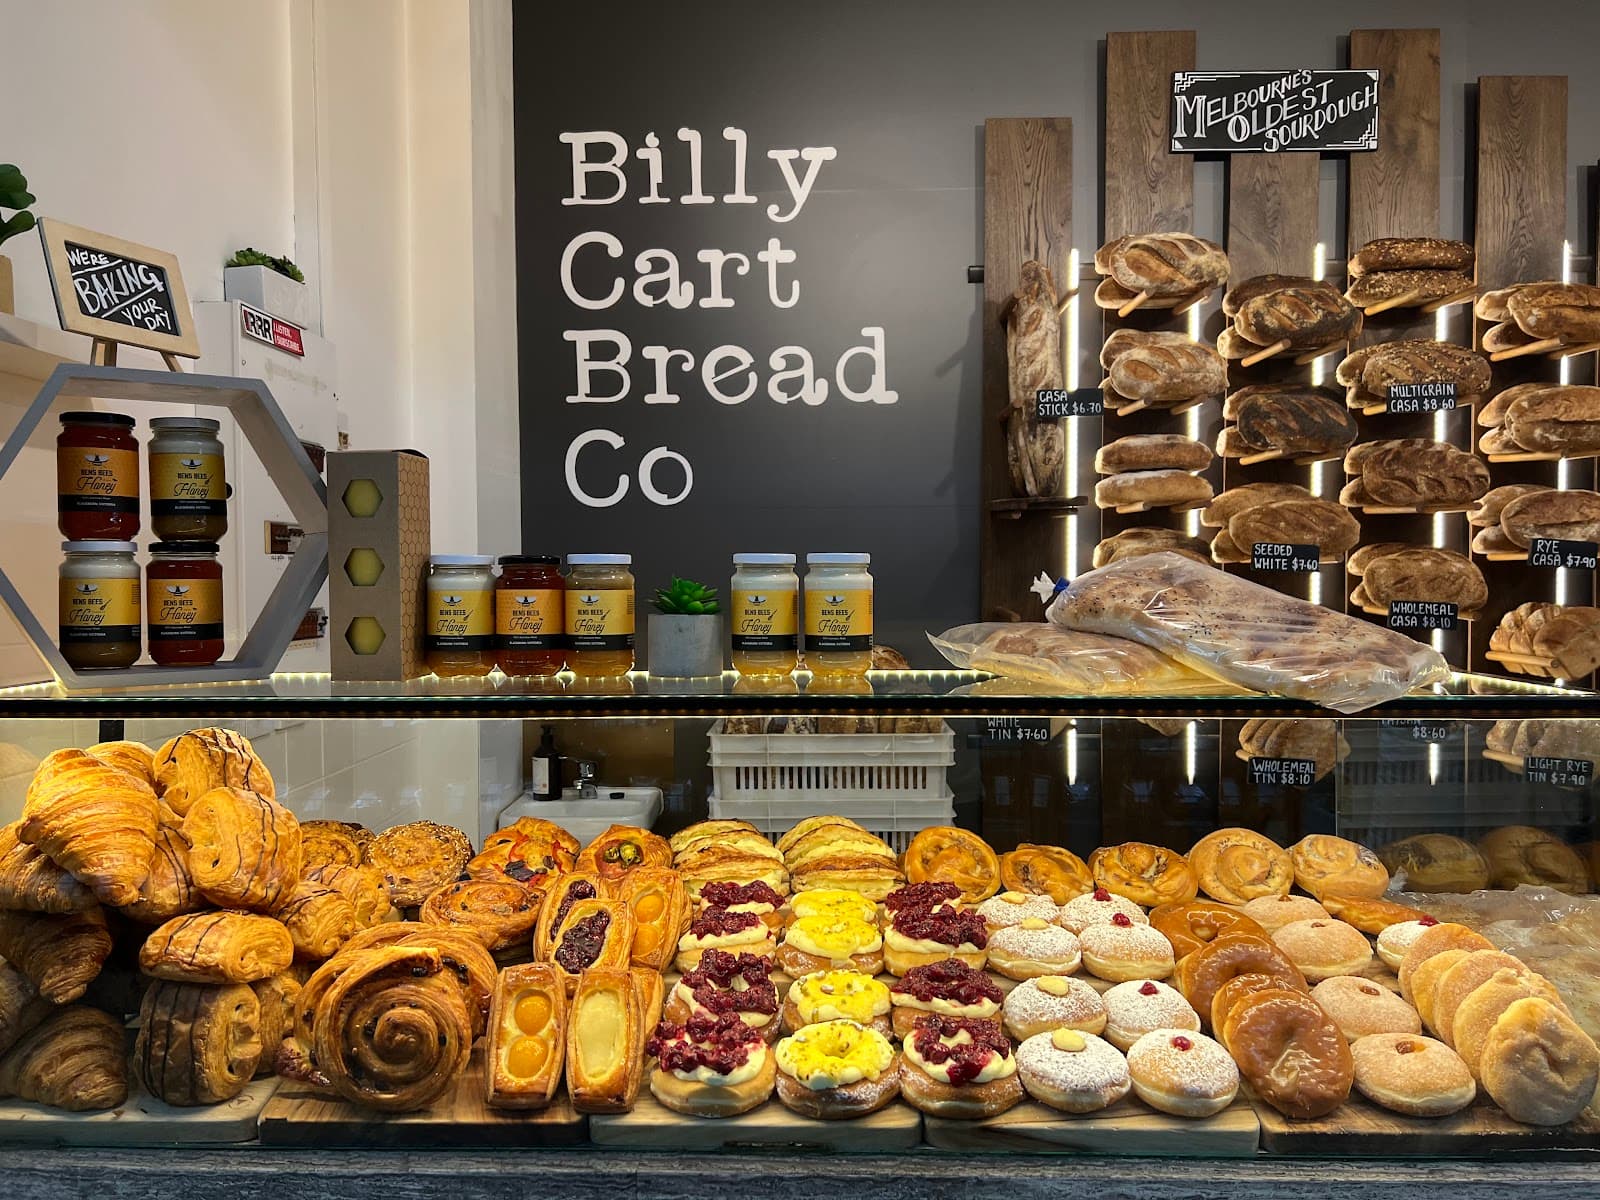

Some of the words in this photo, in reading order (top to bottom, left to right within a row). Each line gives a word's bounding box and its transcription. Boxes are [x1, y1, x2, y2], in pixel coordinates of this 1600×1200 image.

[1227, 79, 1334, 142] OLDEST
[1264, 82, 1378, 152] SOURDOUGH
[558, 126, 837, 222] Billy
[560, 231, 800, 309] Cart
[74, 262, 164, 314] BAKING
[121, 298, 163, 326] YOUR
[144, 310, 171, 330] DAY
[562, 327, 899, 405] Bread
[1039, 390, 1068, 402] CASA
[1390, 383, 1454, 398] MULTIGRAIN
[1038, 403, 1069, 416] STICK
[1072, 401, 1102, 415] $6.70
[1390, 399, 1419, 413] CASA
[564, 429, 694, 508] Co
[76, 476, 117, 494] Honey
[174, 482, 210, 498] Honey
[1254, 543, 1293, 557] SEEDED
[1536, 539, 1560, 554] RYE
[1254, 557, 1288, 571] WHITE
[1291, 556, 1318, 572] $7.60
[1532, 553, 1561, 567] CASA
[1566, 552, 1597, 569] $7.90
[70, 608, 106, 625] Honey
[160, 606, 197, 624] Honey
[1392, 601, 1455, 616] WHOLEMEAL
[436, 618, 468, 635] Honey
[509, 616, 543, 634] Honey
[574, 618, 606, 634] Honey
[740, 618, 772, 634] Honey
[818, 619, 850, 635] Honey
[1390, 615, 1418, 628] CASA
[1422, 615, 1451, 628] $8.10
[987, 717, 1021, 728] WHITE
[987, 728, 1012, 741] TIN
[1016, 727, 1048, 741] $7.60
[1252, 758, 1316, 774] WHOLEMEAL
[1528, 756, 1561, 770] LIGHT
[1566, 760, 1589, 773] RYE
[1252, 772, 1277, 784] TIN
[1280, 772, 1311, 785] $8.10
[1527, 771, 1547, 783] TIN
